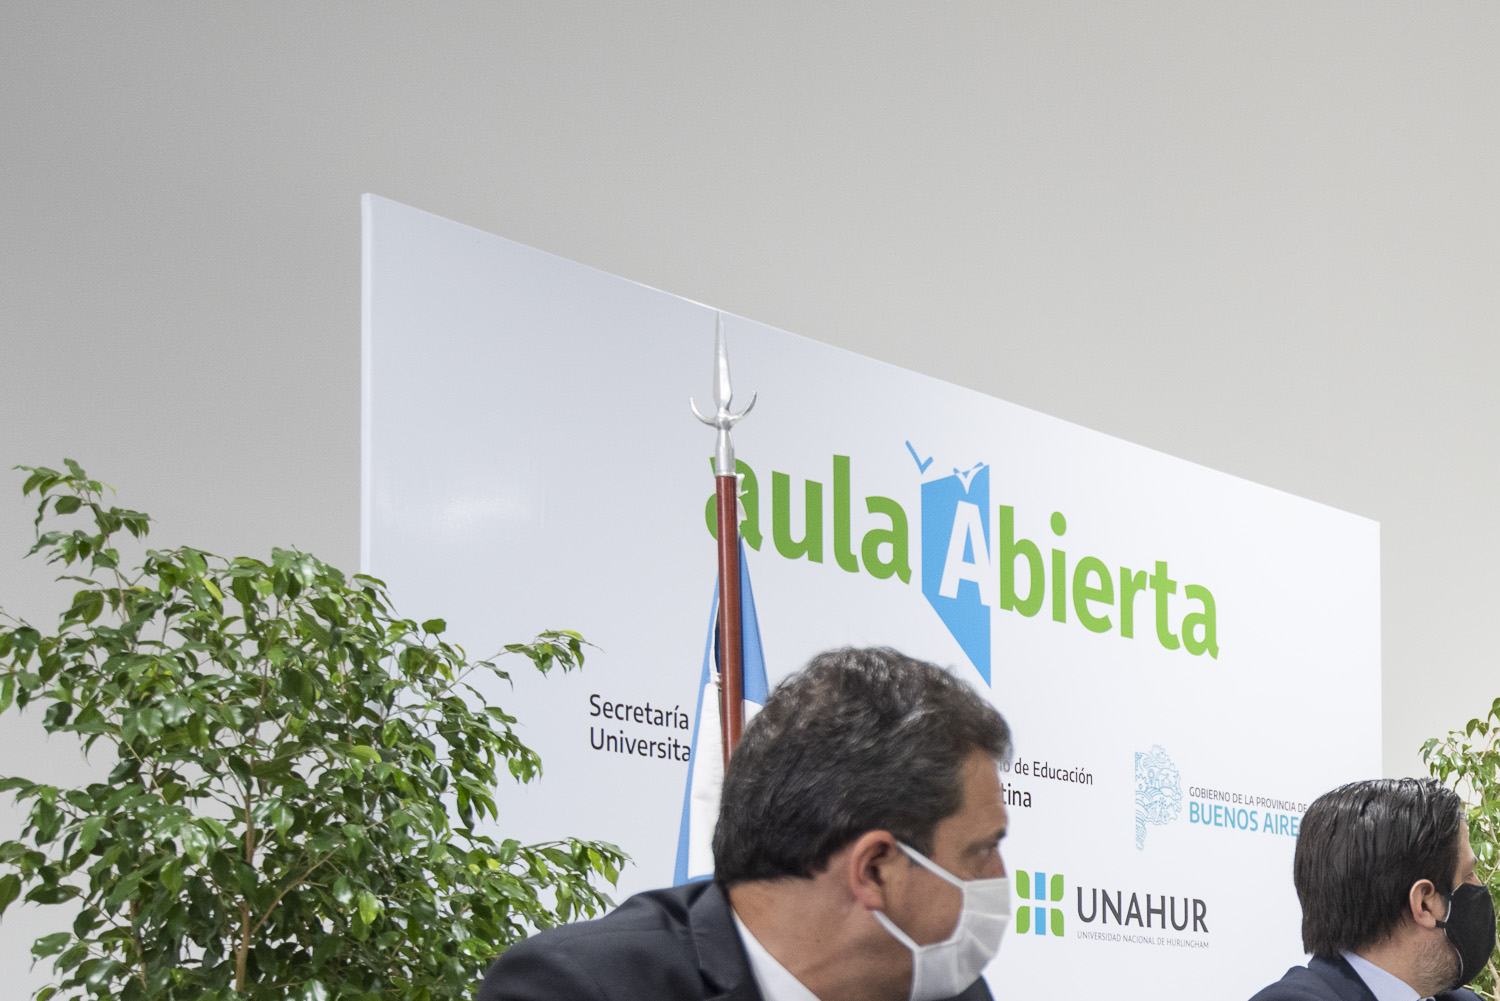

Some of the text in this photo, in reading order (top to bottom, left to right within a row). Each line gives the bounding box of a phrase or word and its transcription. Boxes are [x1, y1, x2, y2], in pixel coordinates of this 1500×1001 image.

[938, 500, 1219, 660] Abierta
[589, 693, 689, 730] Secretaría
[590, 726, 691, 762] Universita
[1014, 757, 1029, 775] de
[1033, 761, 1093, 785] Educación
[1189, 786, 1308, 814] GOBIERNO DE LA PROVINCIA DE
[1189, 801, 1300, 837] BUENOS AIRE
[1077, 886, 1209, 933] UNAHUR
[1077, 930, 1209, 949] UNIVERSIDAD NACIONAL DE HURLINGHAM
